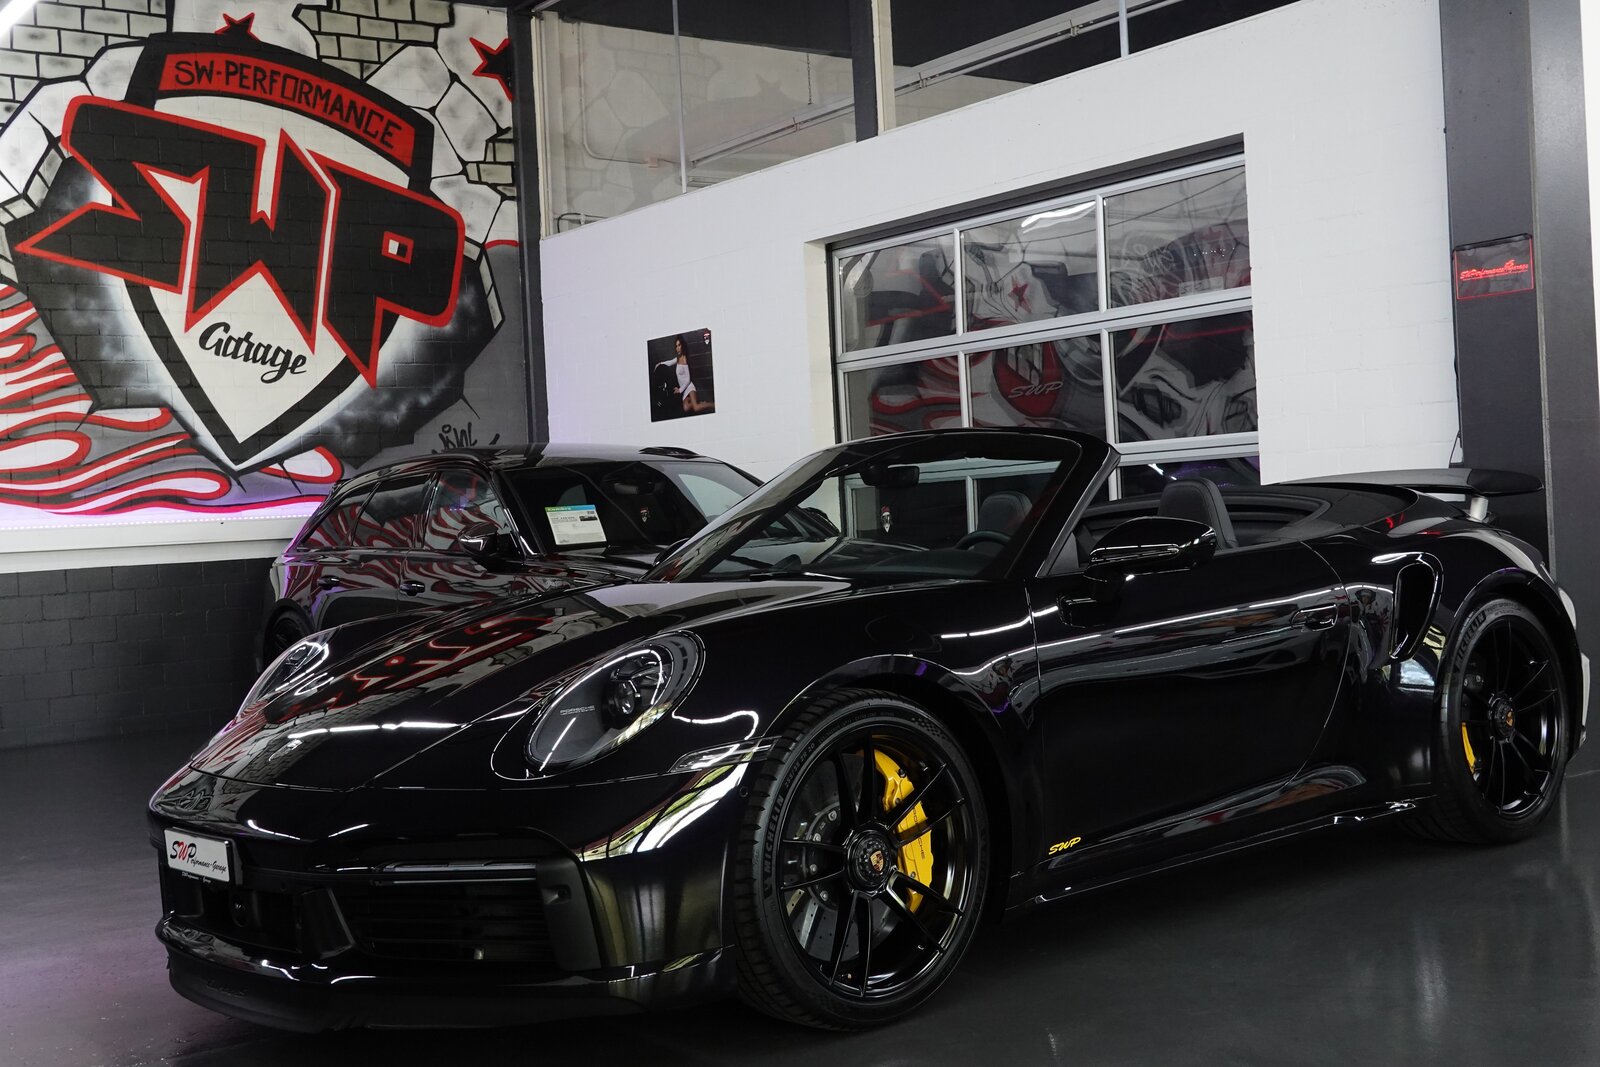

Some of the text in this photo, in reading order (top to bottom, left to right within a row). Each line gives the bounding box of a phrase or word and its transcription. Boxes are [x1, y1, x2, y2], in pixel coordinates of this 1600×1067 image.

[174, 60, 403, 151] SW-PERFORMANCE
[15, 95, 466, 389] SWP
[199, 322, 307, 384] Garage
[763, 795, 785, 875] MICHELIN
[1048, 836, 1082, 855] SWP
